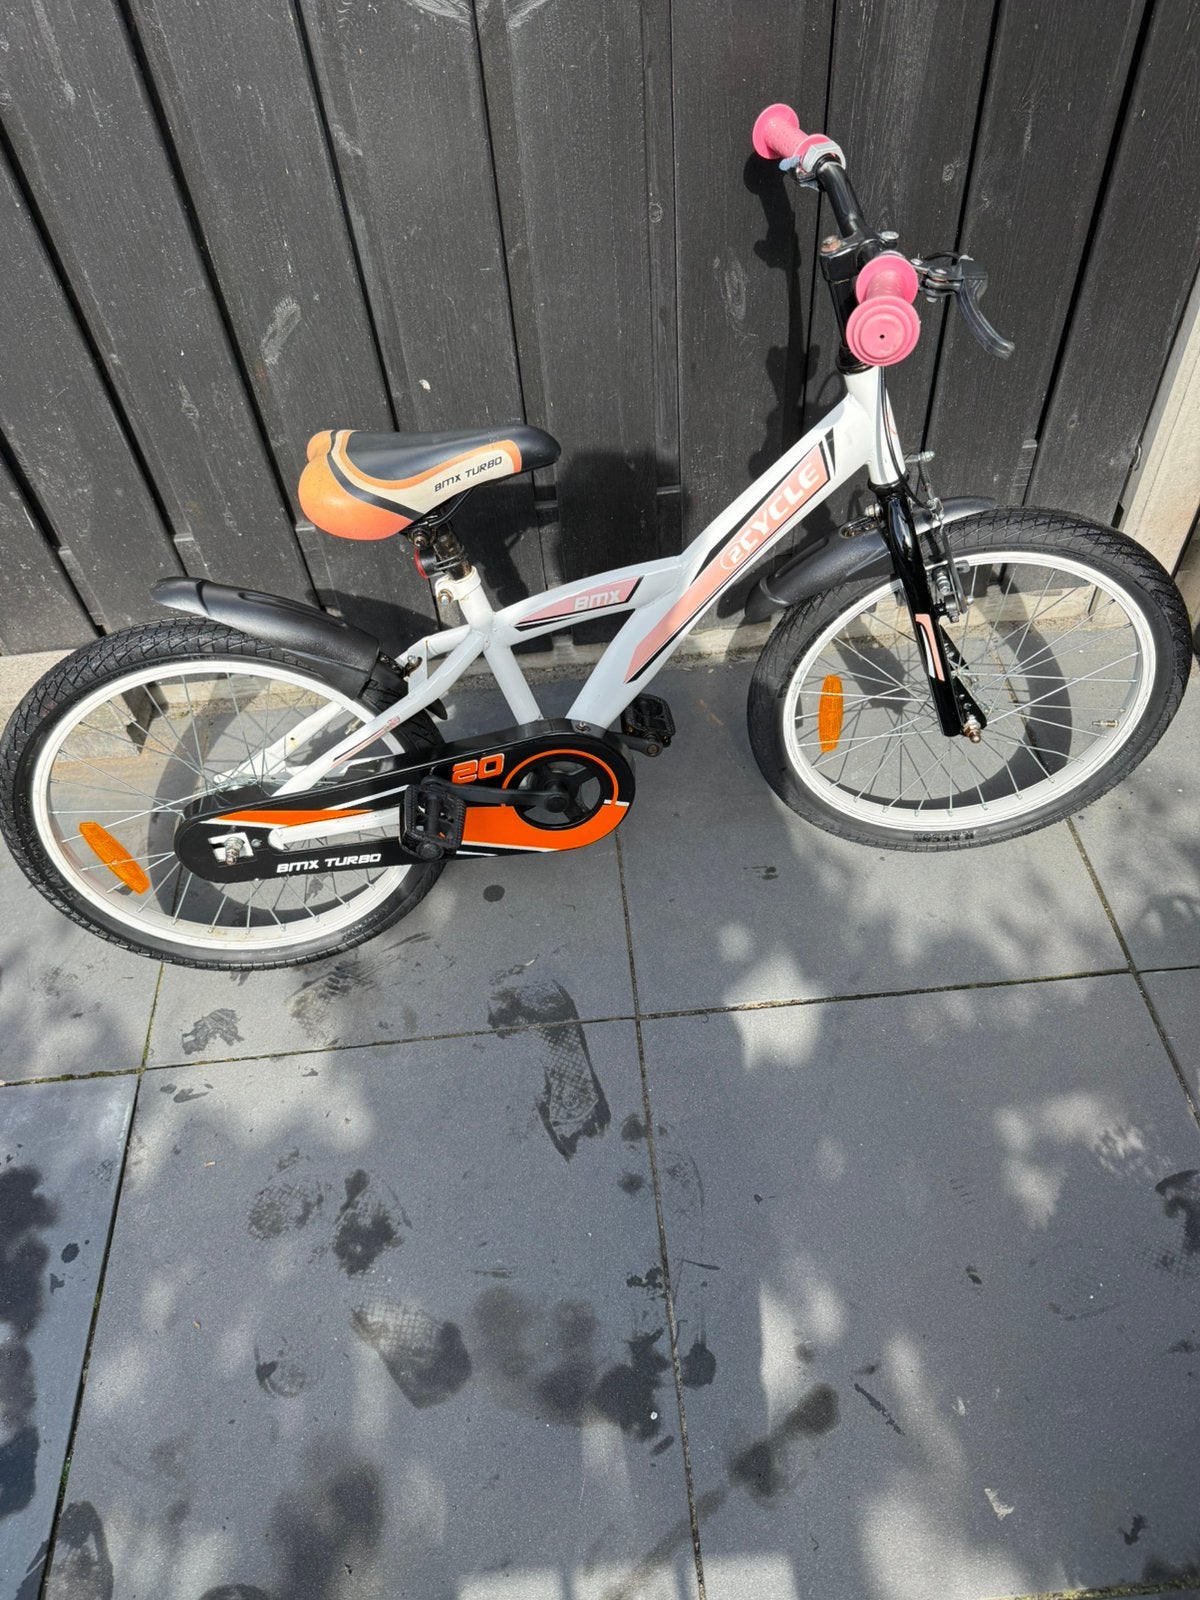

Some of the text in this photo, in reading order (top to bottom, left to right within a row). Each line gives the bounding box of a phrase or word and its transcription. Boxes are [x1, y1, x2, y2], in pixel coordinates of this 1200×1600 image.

[434, 456, 503, 492] BMX TURBO
[574, 590, 621, 611] BMX
[452, 753, 505, 784] 20
[276, 853, 382, 873] BMX TURBO
